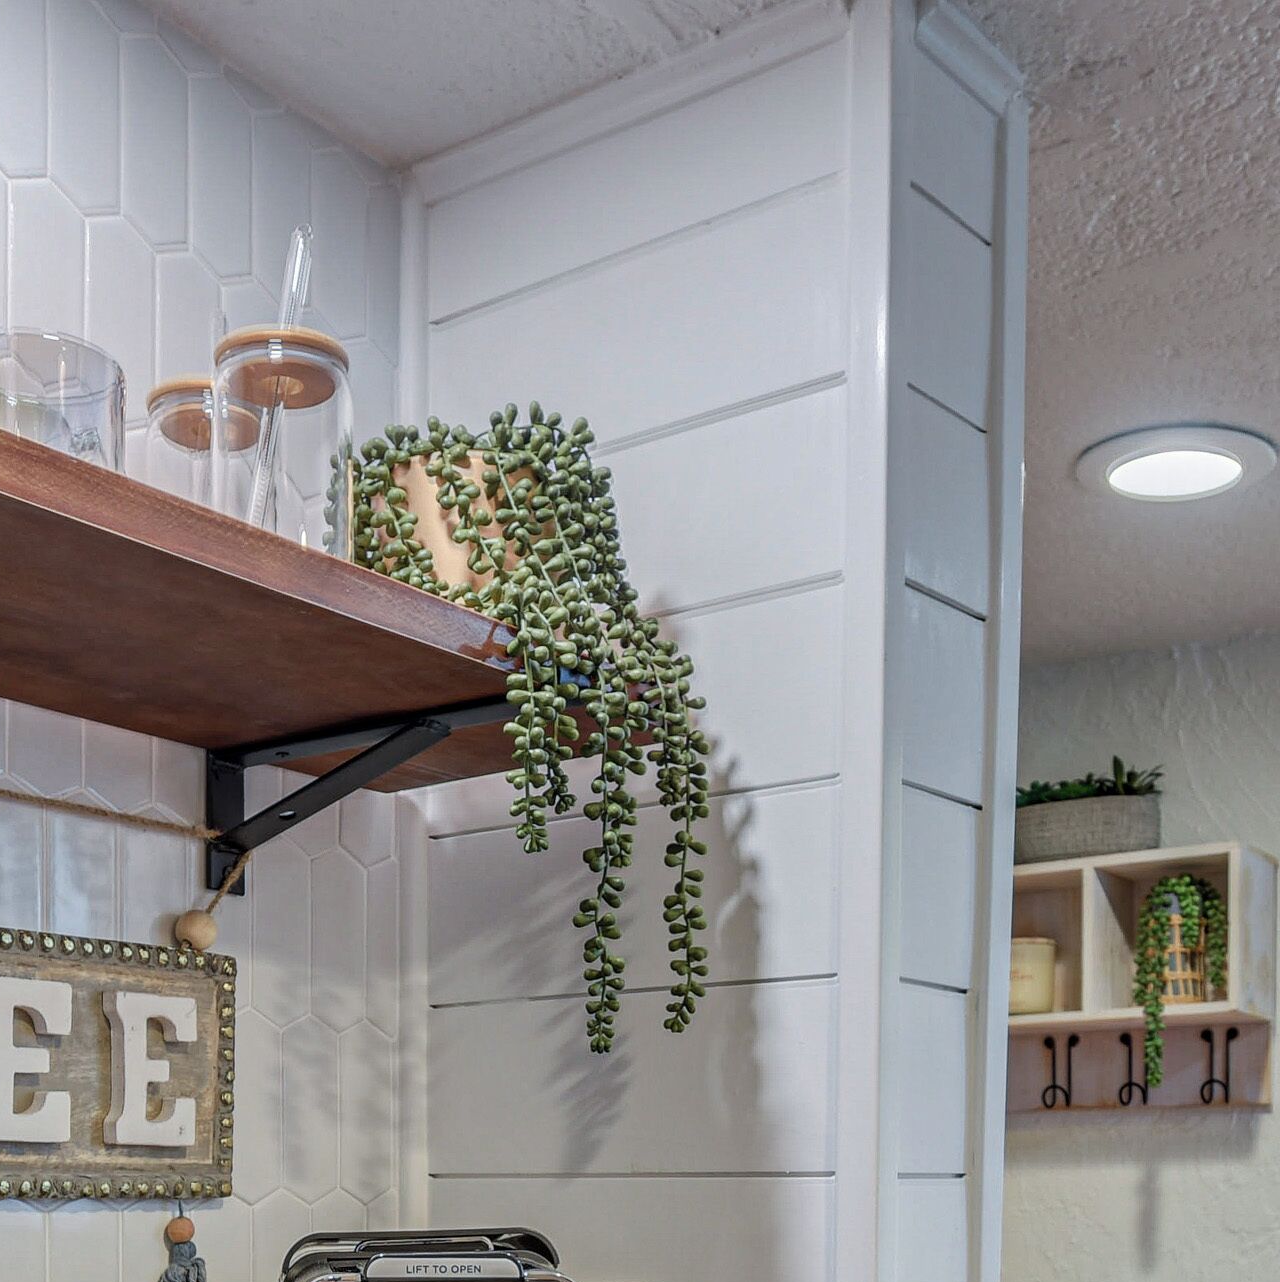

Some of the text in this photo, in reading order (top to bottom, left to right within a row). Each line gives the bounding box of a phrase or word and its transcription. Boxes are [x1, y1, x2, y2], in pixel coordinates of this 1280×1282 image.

[406, 1264, 482, 1274] LIFT TO OPEN
